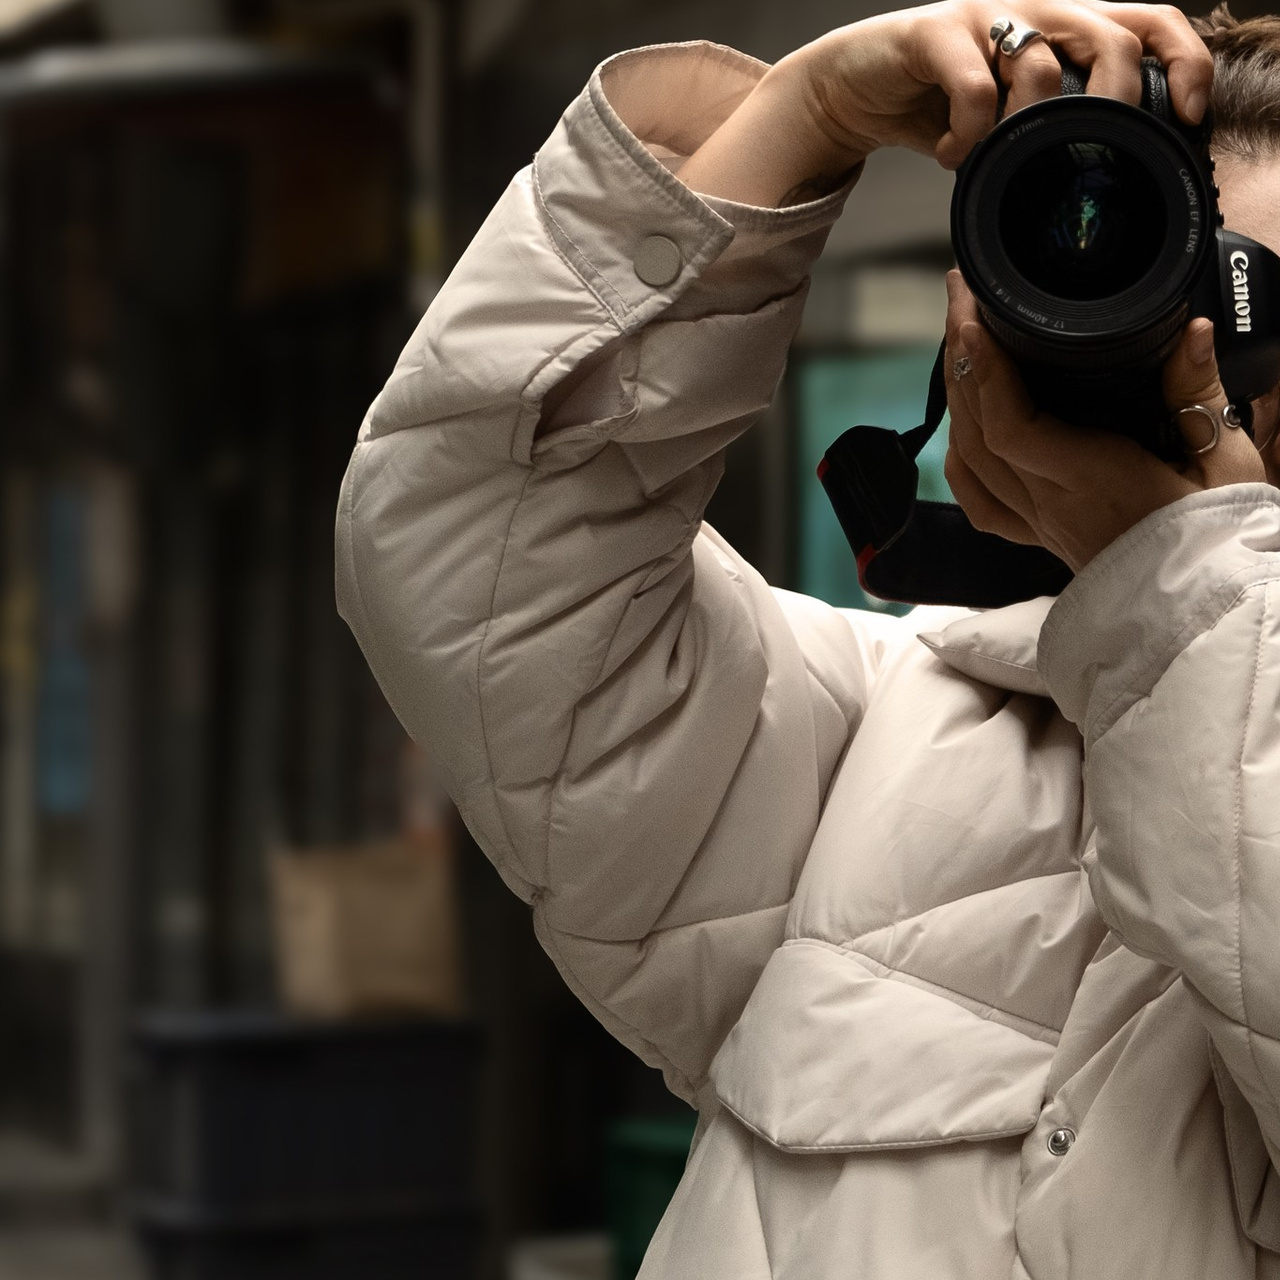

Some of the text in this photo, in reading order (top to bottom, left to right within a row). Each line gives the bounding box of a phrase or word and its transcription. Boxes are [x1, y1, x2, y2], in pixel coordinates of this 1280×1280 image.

[1178, 168, 1199, 254] CANON EF LENS
[1229, 250, 1252, 332] Canon
